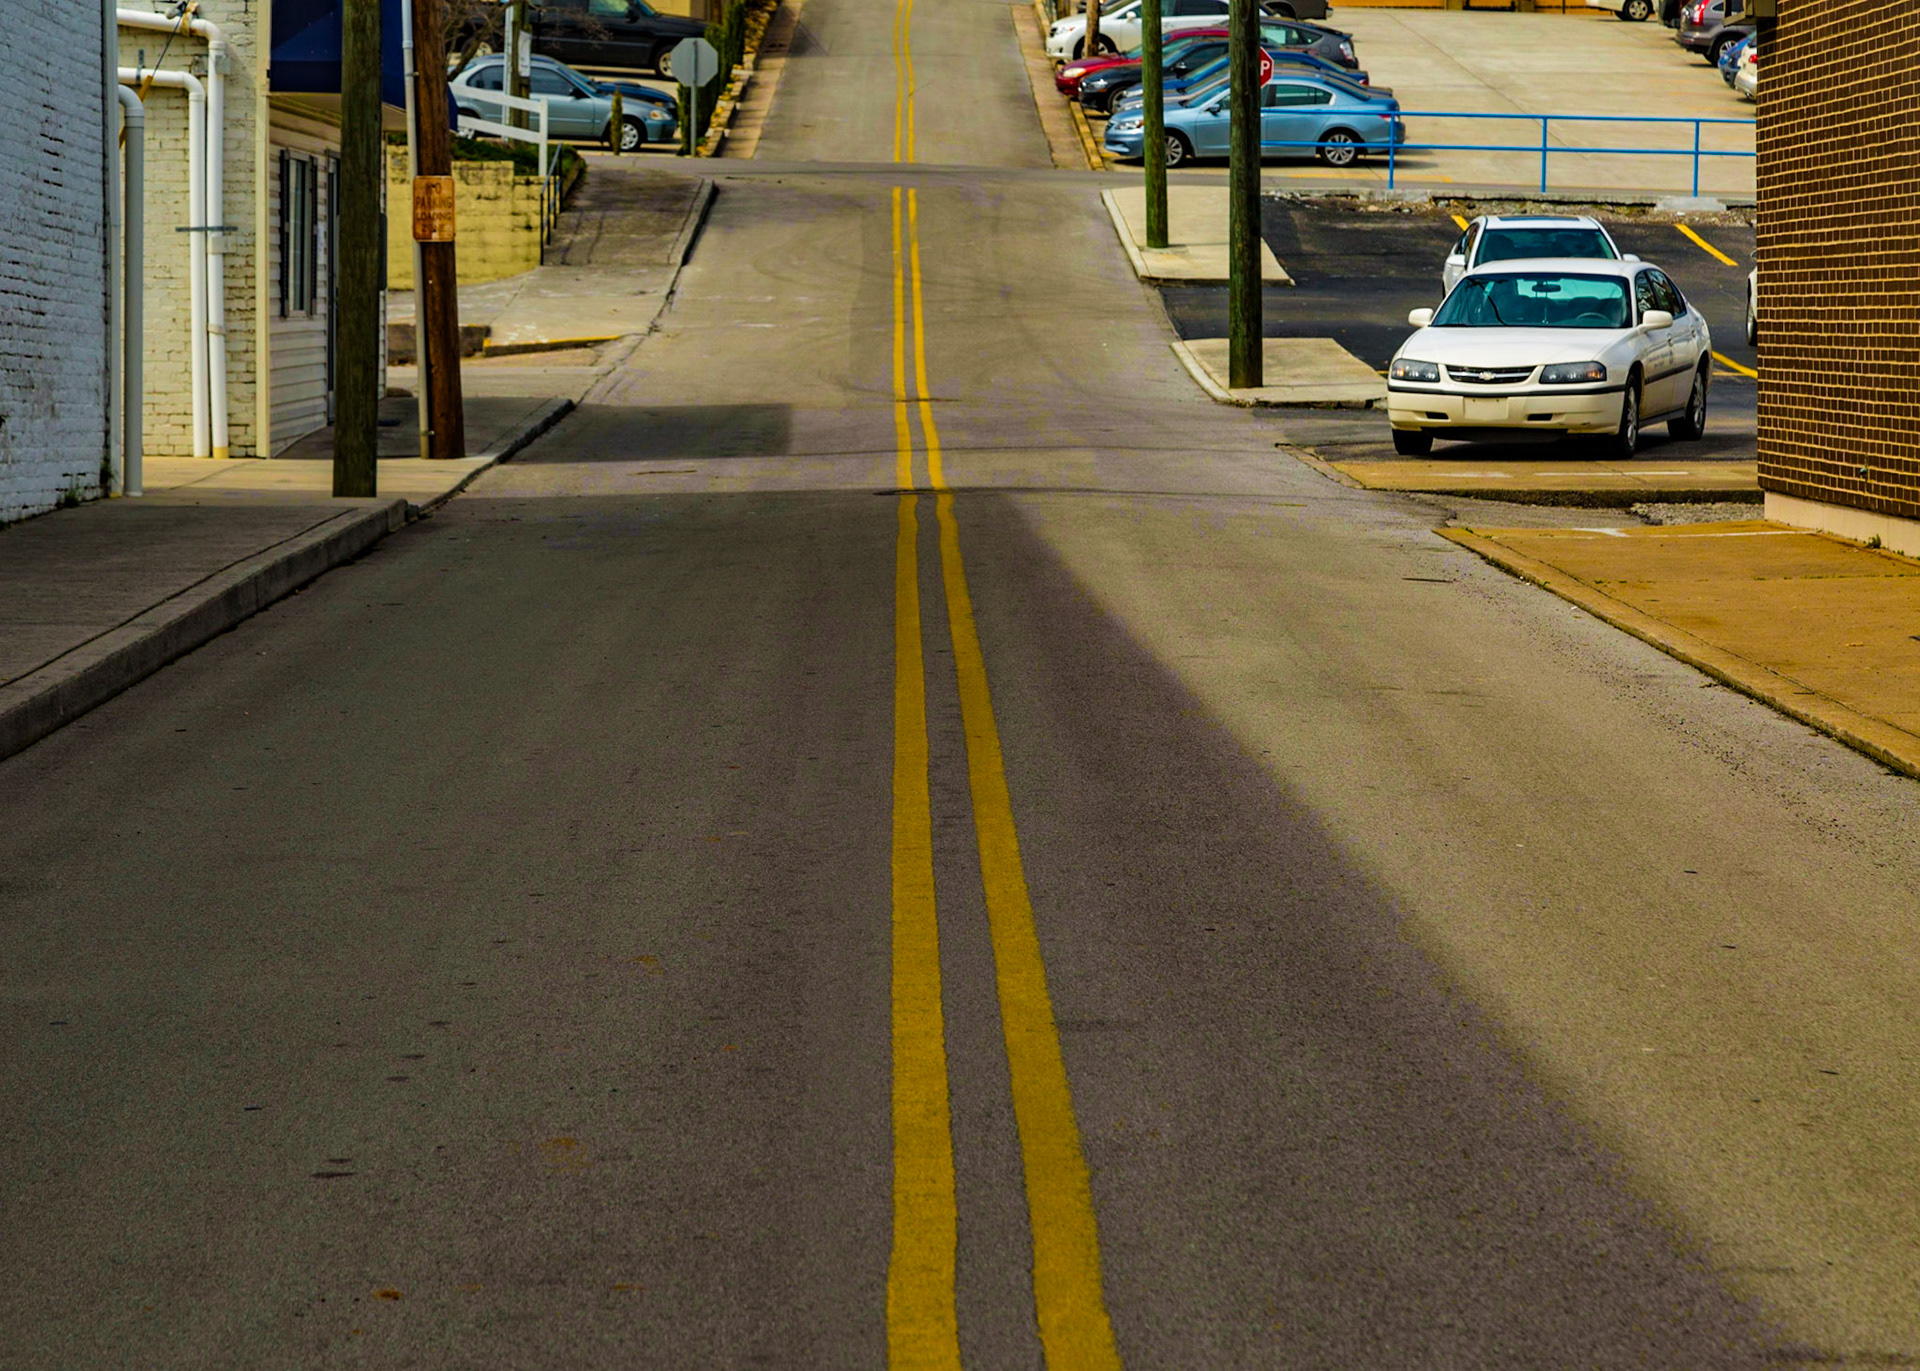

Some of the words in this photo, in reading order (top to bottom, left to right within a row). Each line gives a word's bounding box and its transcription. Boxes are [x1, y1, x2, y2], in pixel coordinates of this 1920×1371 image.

[425, 182, 442, 196] NO
[415, 196, 452, 209] PARKING
[415, 211, 452, 221] LOADING
